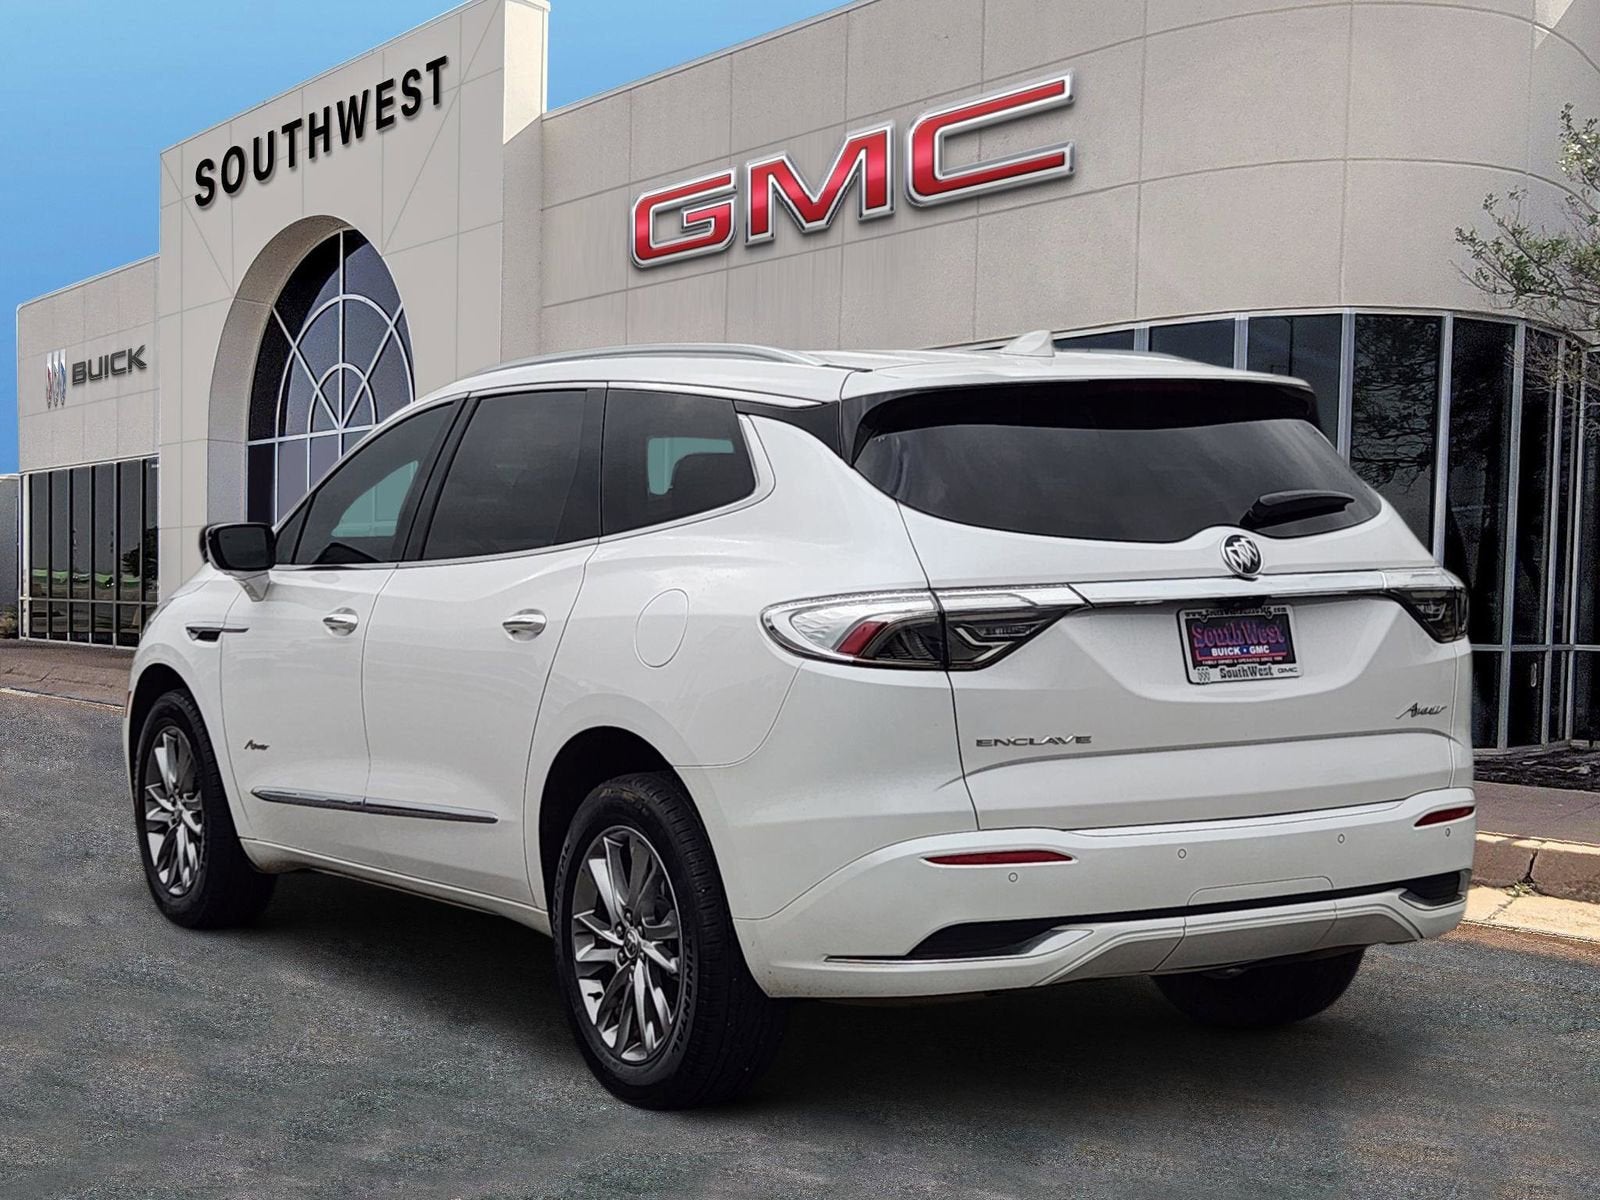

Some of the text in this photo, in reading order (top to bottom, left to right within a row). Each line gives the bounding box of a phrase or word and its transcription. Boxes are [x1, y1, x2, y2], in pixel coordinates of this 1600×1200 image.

[194, 55, 448, 208] SOUTHWEST
[630, 70, 1075, 268] GMC
[72, 344, 147, 386] BUICK
[1211, 645, 1270, 657] BUICK GMC
[1220, 665, 1274, 680] SouthWest
[1278, 666, 1298, 674] GMC
[976, 735, 1092, 747] ENCLAVE
